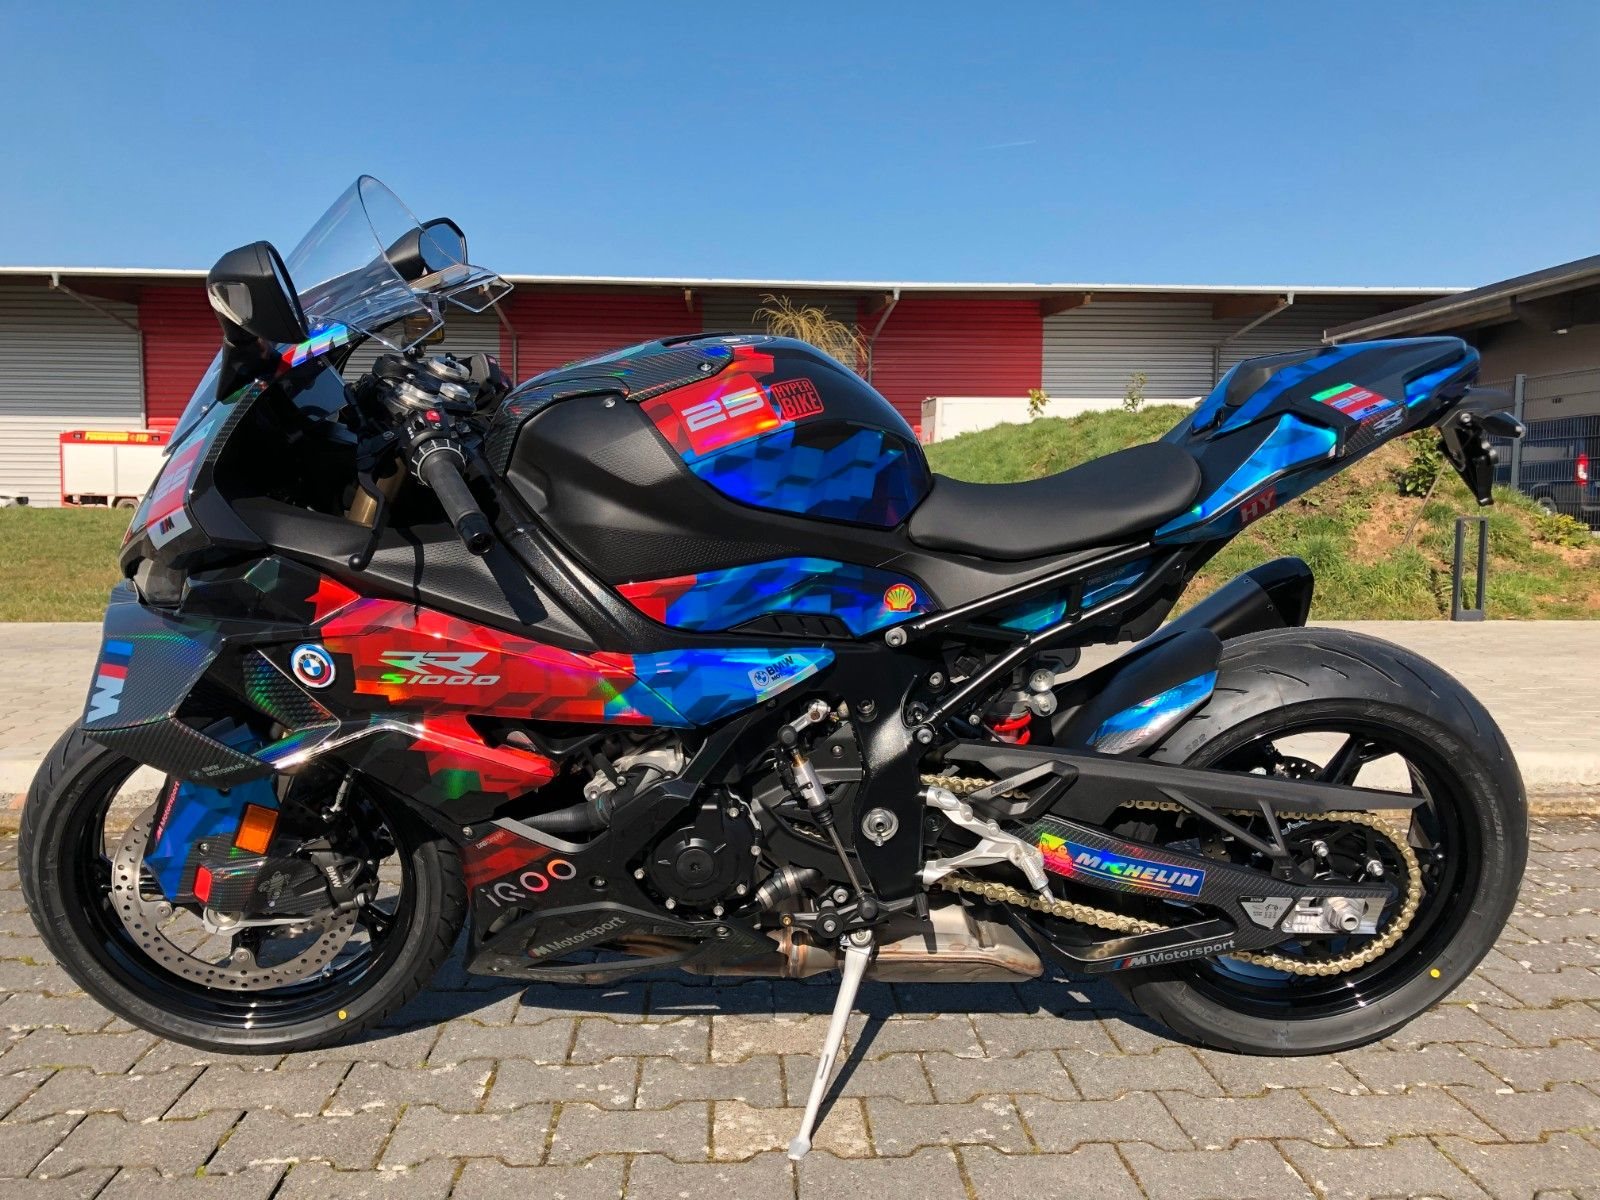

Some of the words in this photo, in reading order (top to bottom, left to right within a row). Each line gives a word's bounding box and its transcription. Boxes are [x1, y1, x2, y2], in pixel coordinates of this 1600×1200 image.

[775, 380, 812, 398] HYPER
[1330, 391, 1373, 410] 25
[681, 387, 764, 432] 25
[781, 391, 820, 417] BIKE
[765, 656, 794, 676] BMW
[376, 673, 501, 686] S1000
[160, 781, 180, 828] Motorsport
[326, 866, 342, 887] BMW
[1075, 852, 1200, 888] MICHELIN
[545, 916, 626, 952] Motorsport
[1149, 940, 1236, 964] Motorsport
